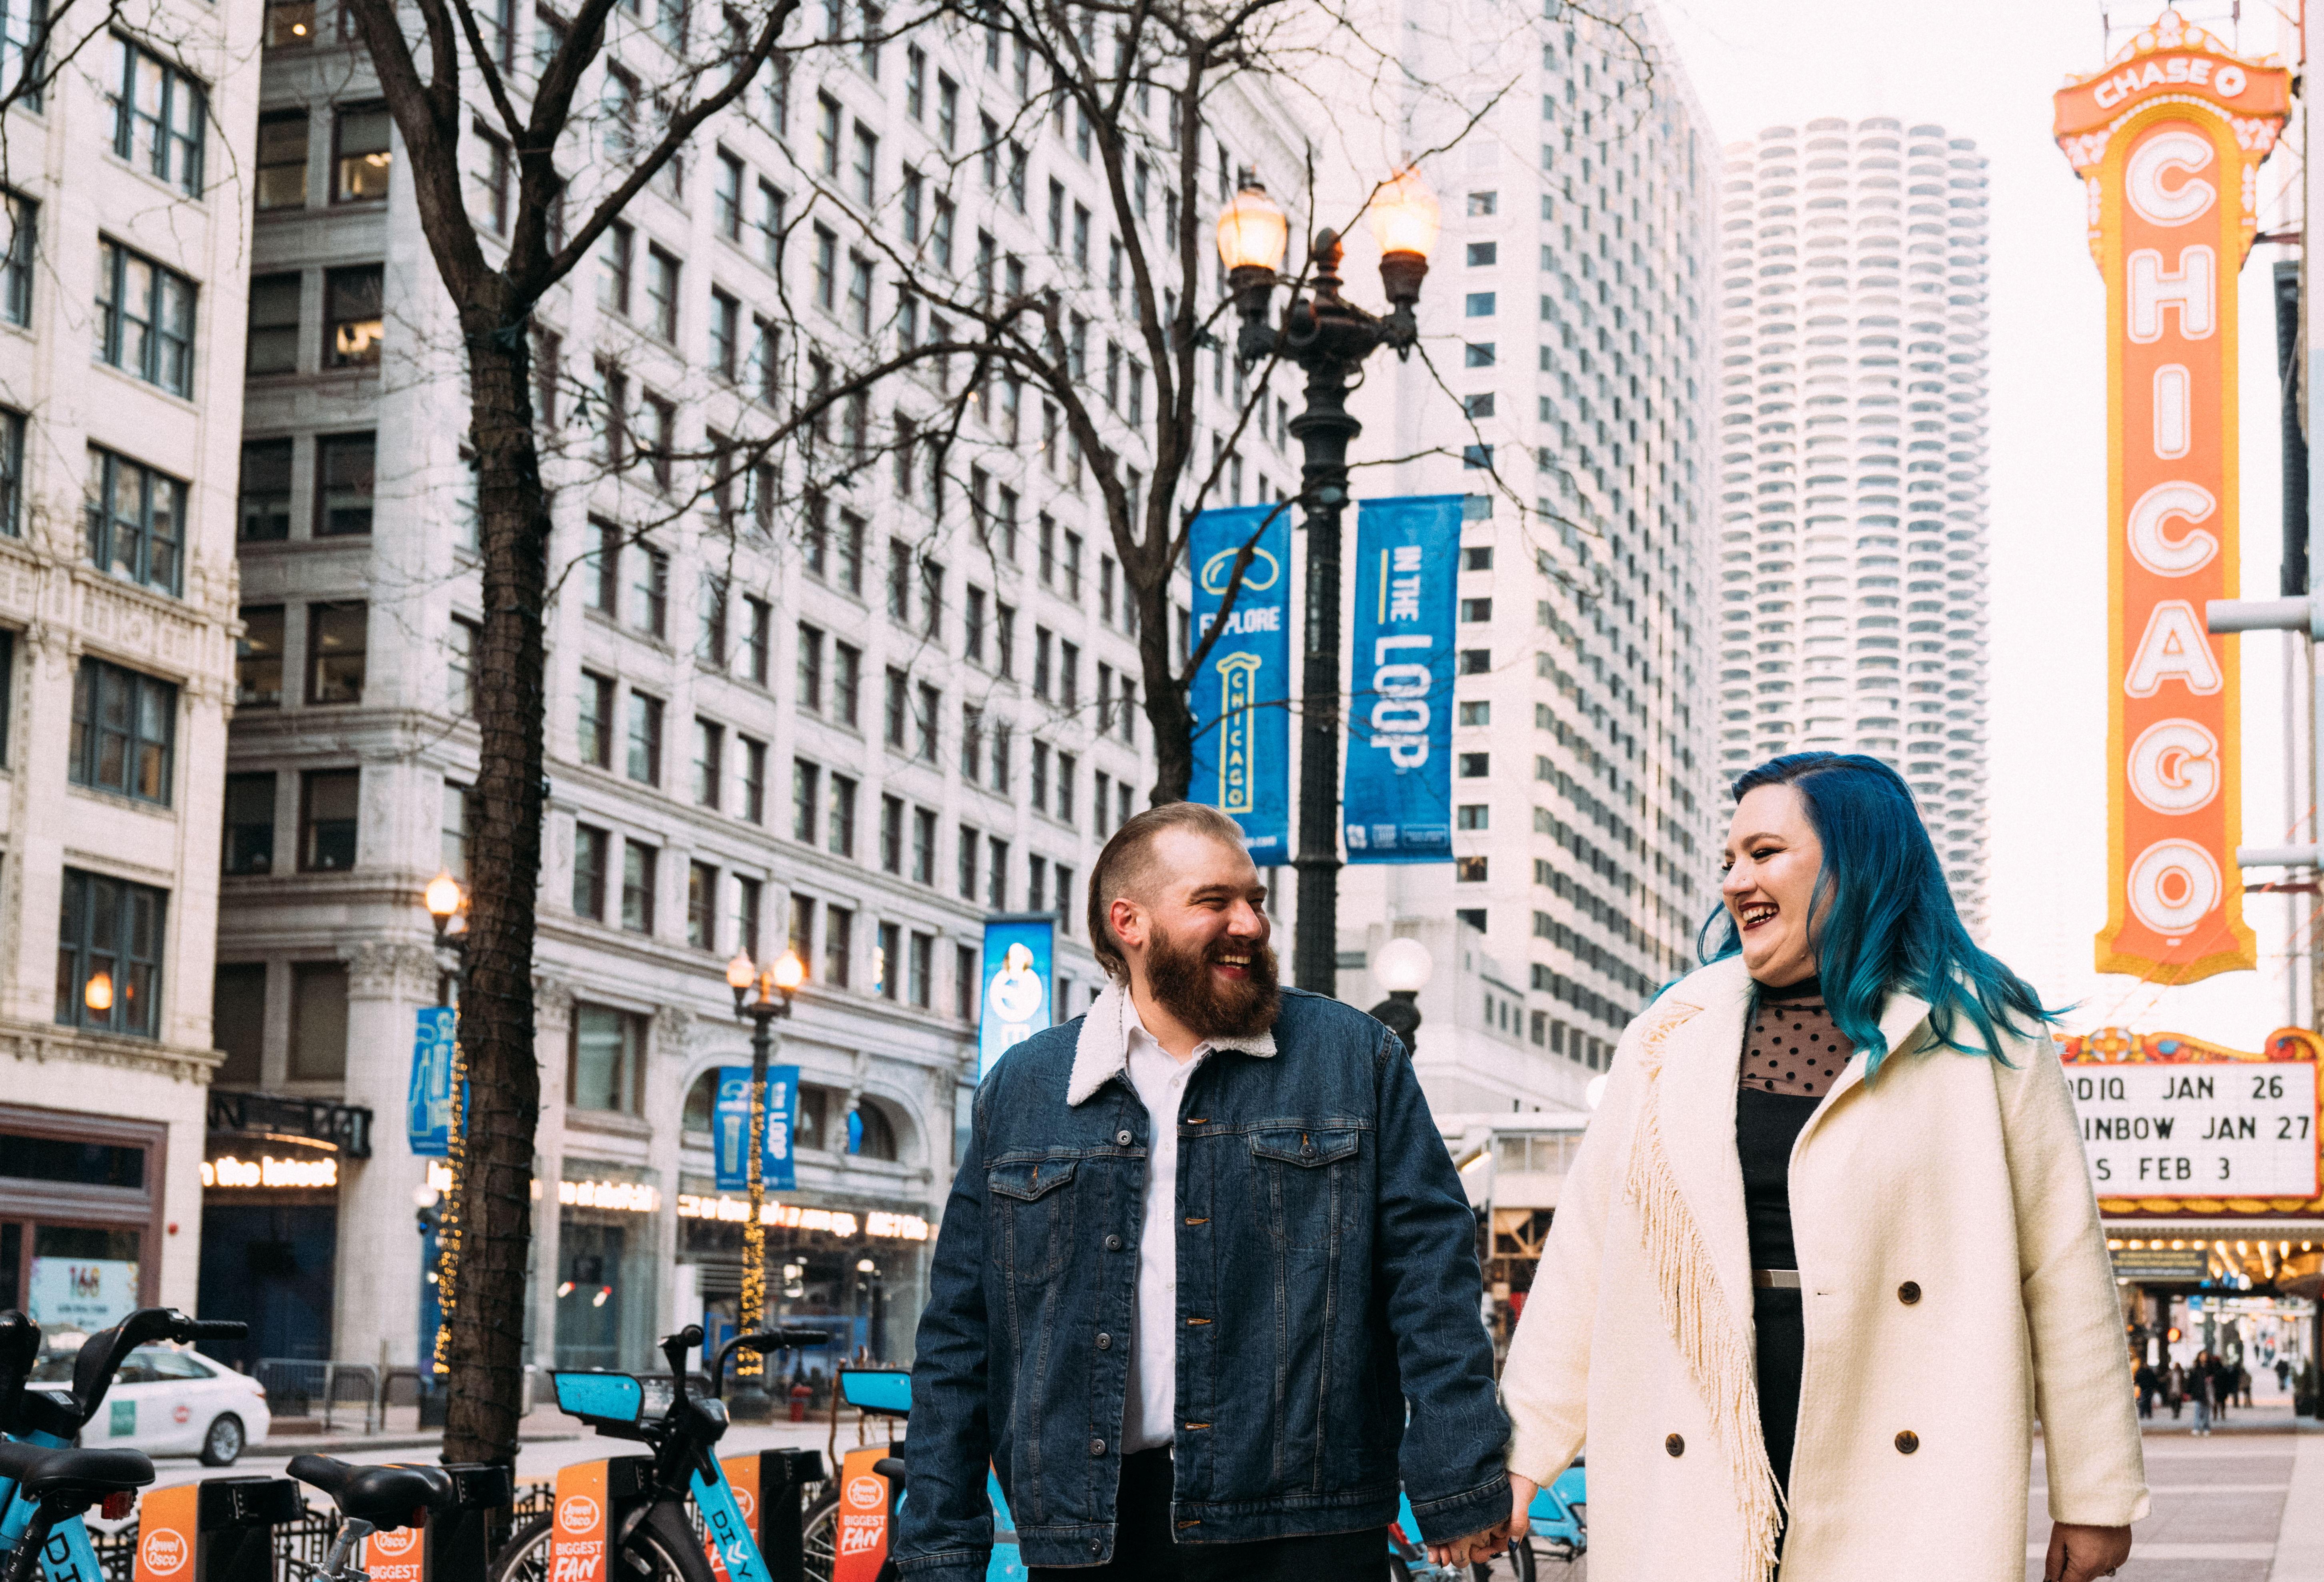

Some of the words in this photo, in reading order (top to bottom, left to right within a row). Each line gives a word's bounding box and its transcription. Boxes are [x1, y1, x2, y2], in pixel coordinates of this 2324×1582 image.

[2094, 58, 2214, 110] CHASE
[2124, 131, 2223, 935] CHICAGO
[1393, 545, 1422, 572] IN
[1390, 575, 1421, 622] THE
[1199, 606, 1281, 638] EPLORE
[1370, 635, 1433, 769] LOOP
[1228, 672, 1244, 806] CHICAGO
[2162, 1076, 2214, 1099] JAN
[2252, 1076, 2284, 1099] 26
[2202, 1116, 2256, 1139] JAN
[2277, 1116, 2310, 1139] 27
[2139, 1157, 2191, 1180] FEB
[2218, 1157, 2230, 1180] 3
[843, 1515, 886, 1527] BIGGEST
[148, 1536, 180, 1553] Jewel
[379, 1534, 407, 1548] Osco
[555, 1540, 603, 1556] BIGGEST
[841, 1527, 884, 1551] FAN
[148, 1551, 177, 1566] Osco
[553, 1554, 602, 1582] FAN
[369, 1564, 420, 1580] BIGGEST
